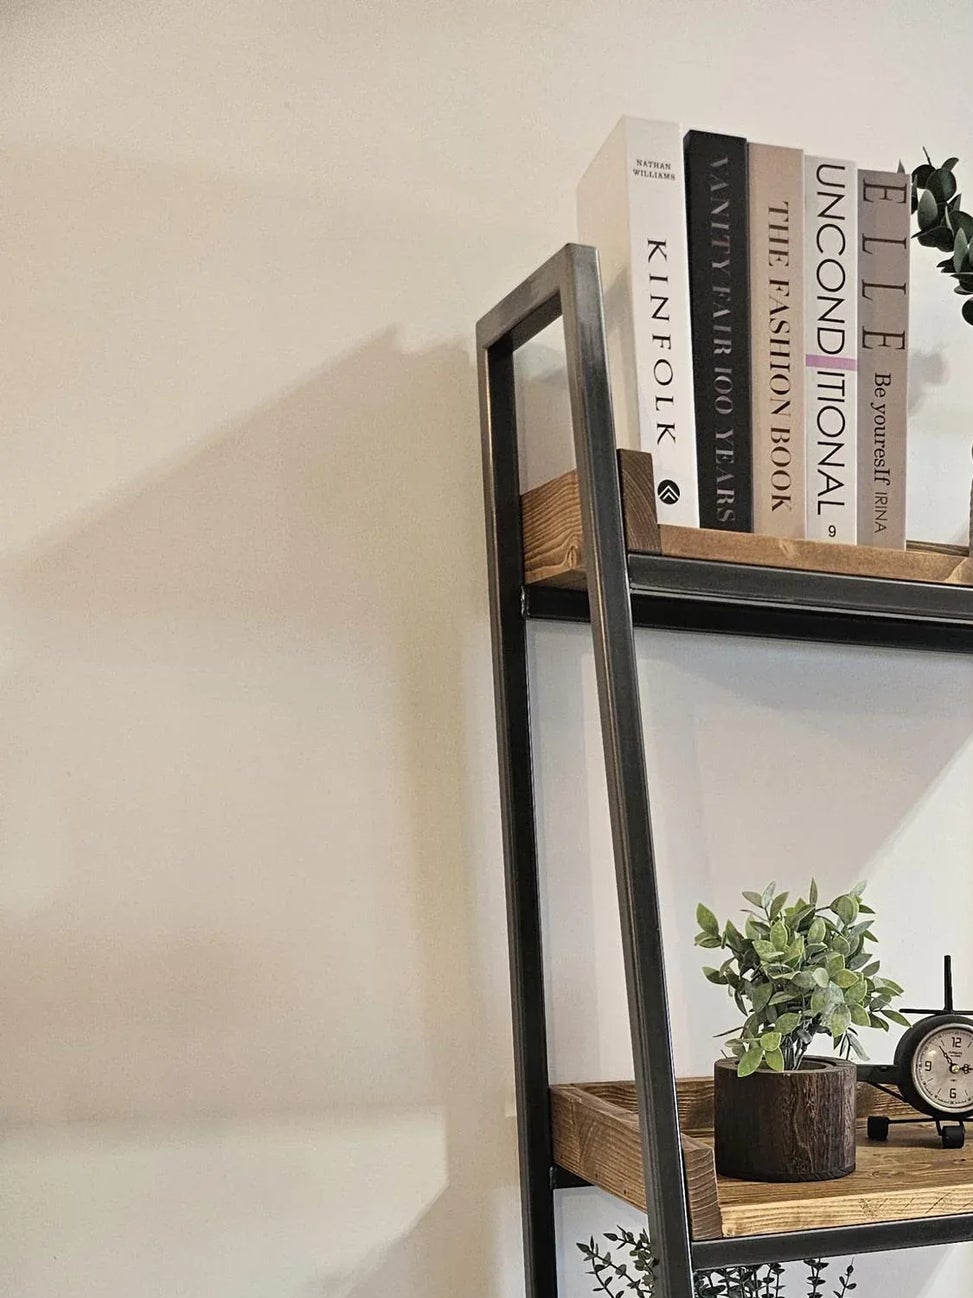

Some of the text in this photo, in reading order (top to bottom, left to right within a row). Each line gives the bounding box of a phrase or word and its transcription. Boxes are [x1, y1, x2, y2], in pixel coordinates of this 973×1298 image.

[633, 169, 676, 181] WILLIAMS
[636, 159, 671, 170] NATHAN
[709, 154, 731, 277] VANITY
[861, 178, 907, 350] ELLE
[647, 238, 676, 445] KINFOLK
[712, 286, 732, 356] FAIR
[768, 201, 793, 512] THE FASHION BOOK
[874, 372, 892, 398] Be
[715, 428, 736, 522] YEARS
[874, 492, 888, 534] IRINA
[952, 1037, 962, 1048] 12
[925, 1060, 932, 1072] 9
[949, 1088, 957, 1098] 6
